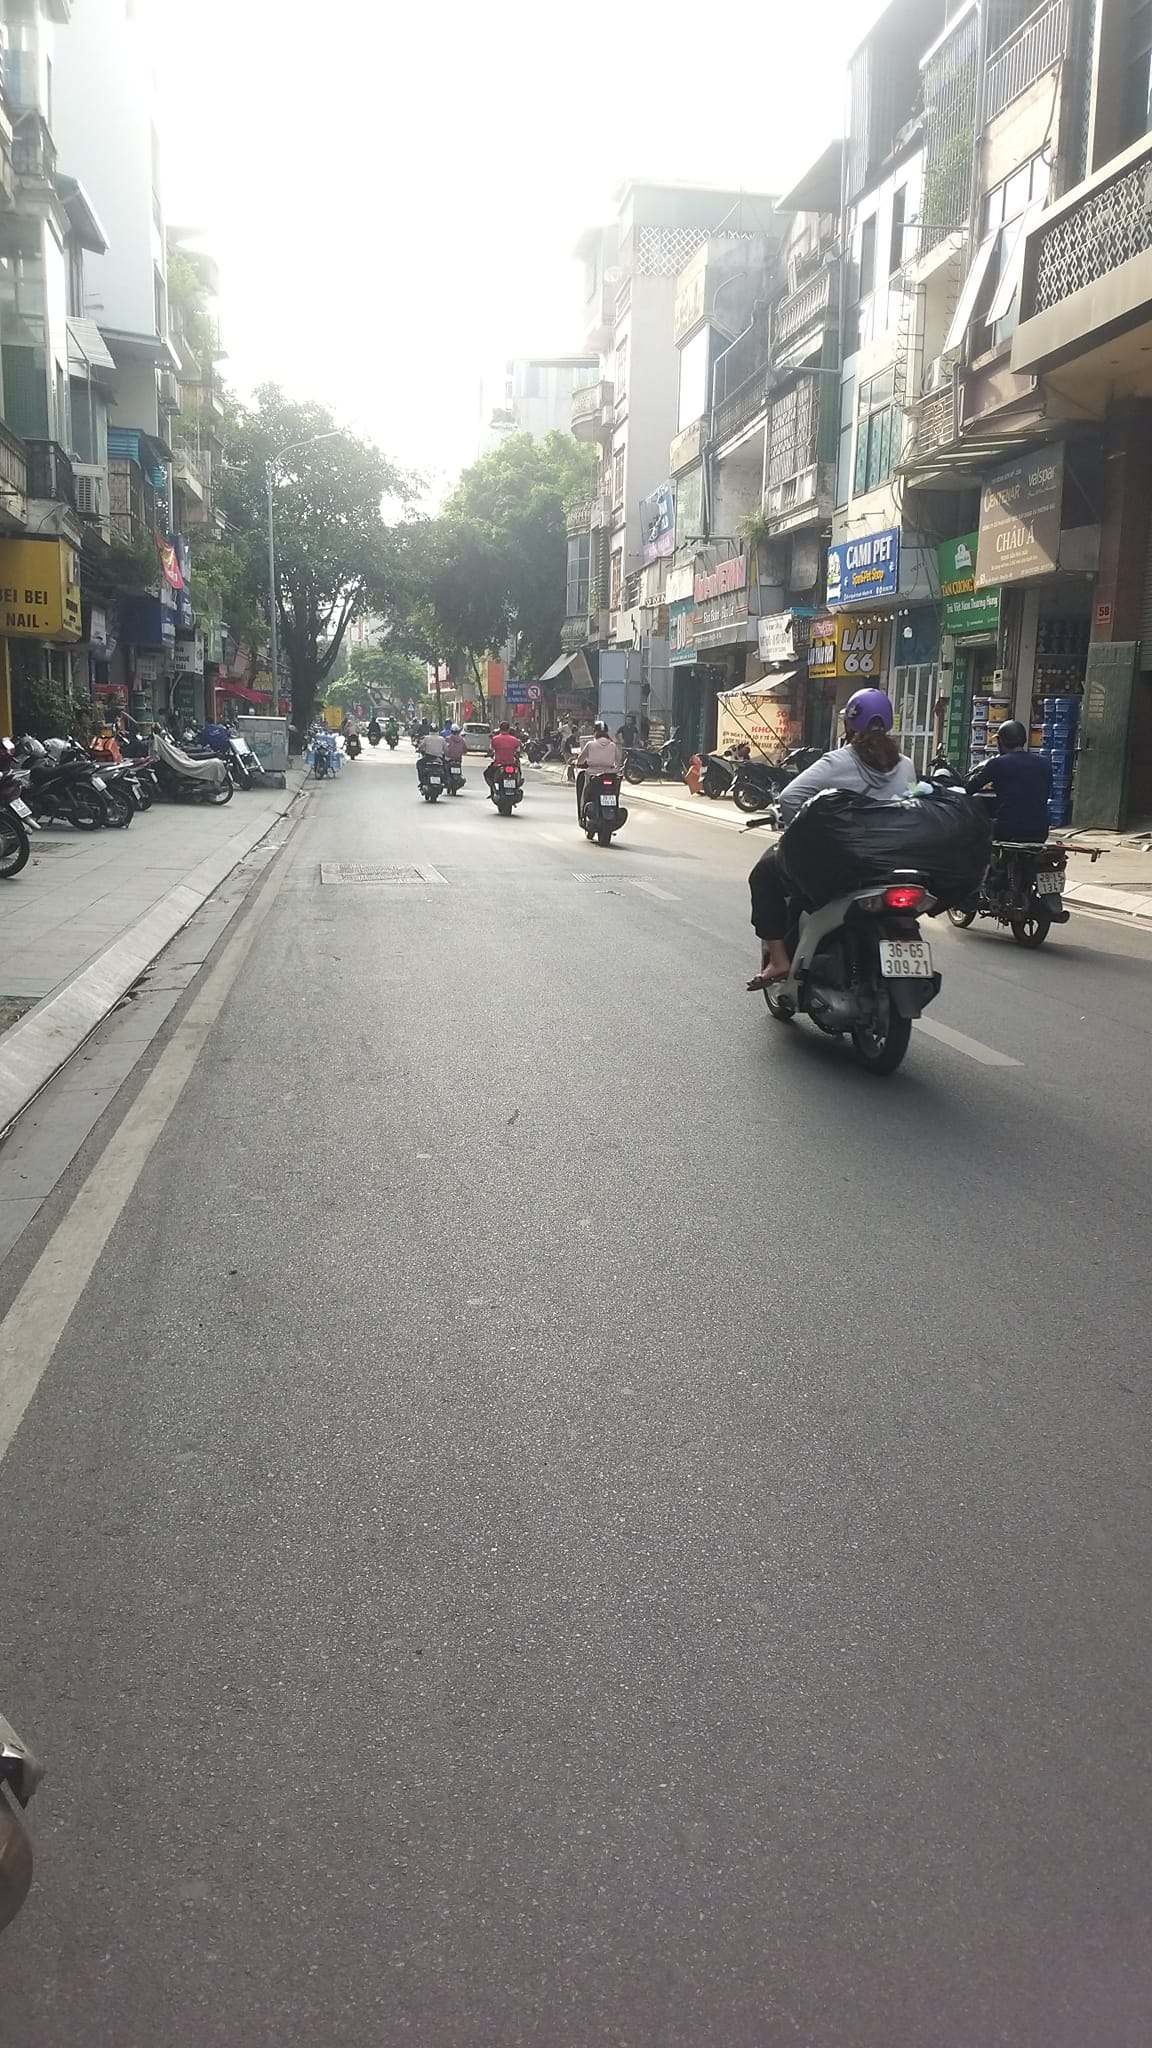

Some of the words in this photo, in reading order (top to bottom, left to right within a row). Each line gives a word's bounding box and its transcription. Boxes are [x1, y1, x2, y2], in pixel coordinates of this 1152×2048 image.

[1028, 465, 1056, 487] valspar
[996, 525, 1025, 553] CHÂU
[846, 541, 871, 570] CAMI
[873, 535, 893, 563] PET
[25, 589, 48, 605] BEI
[6, 612, 40, 628] NAIL
[844, 653, 874, 672] 66
[886, 959, 929, 975] 309.21
